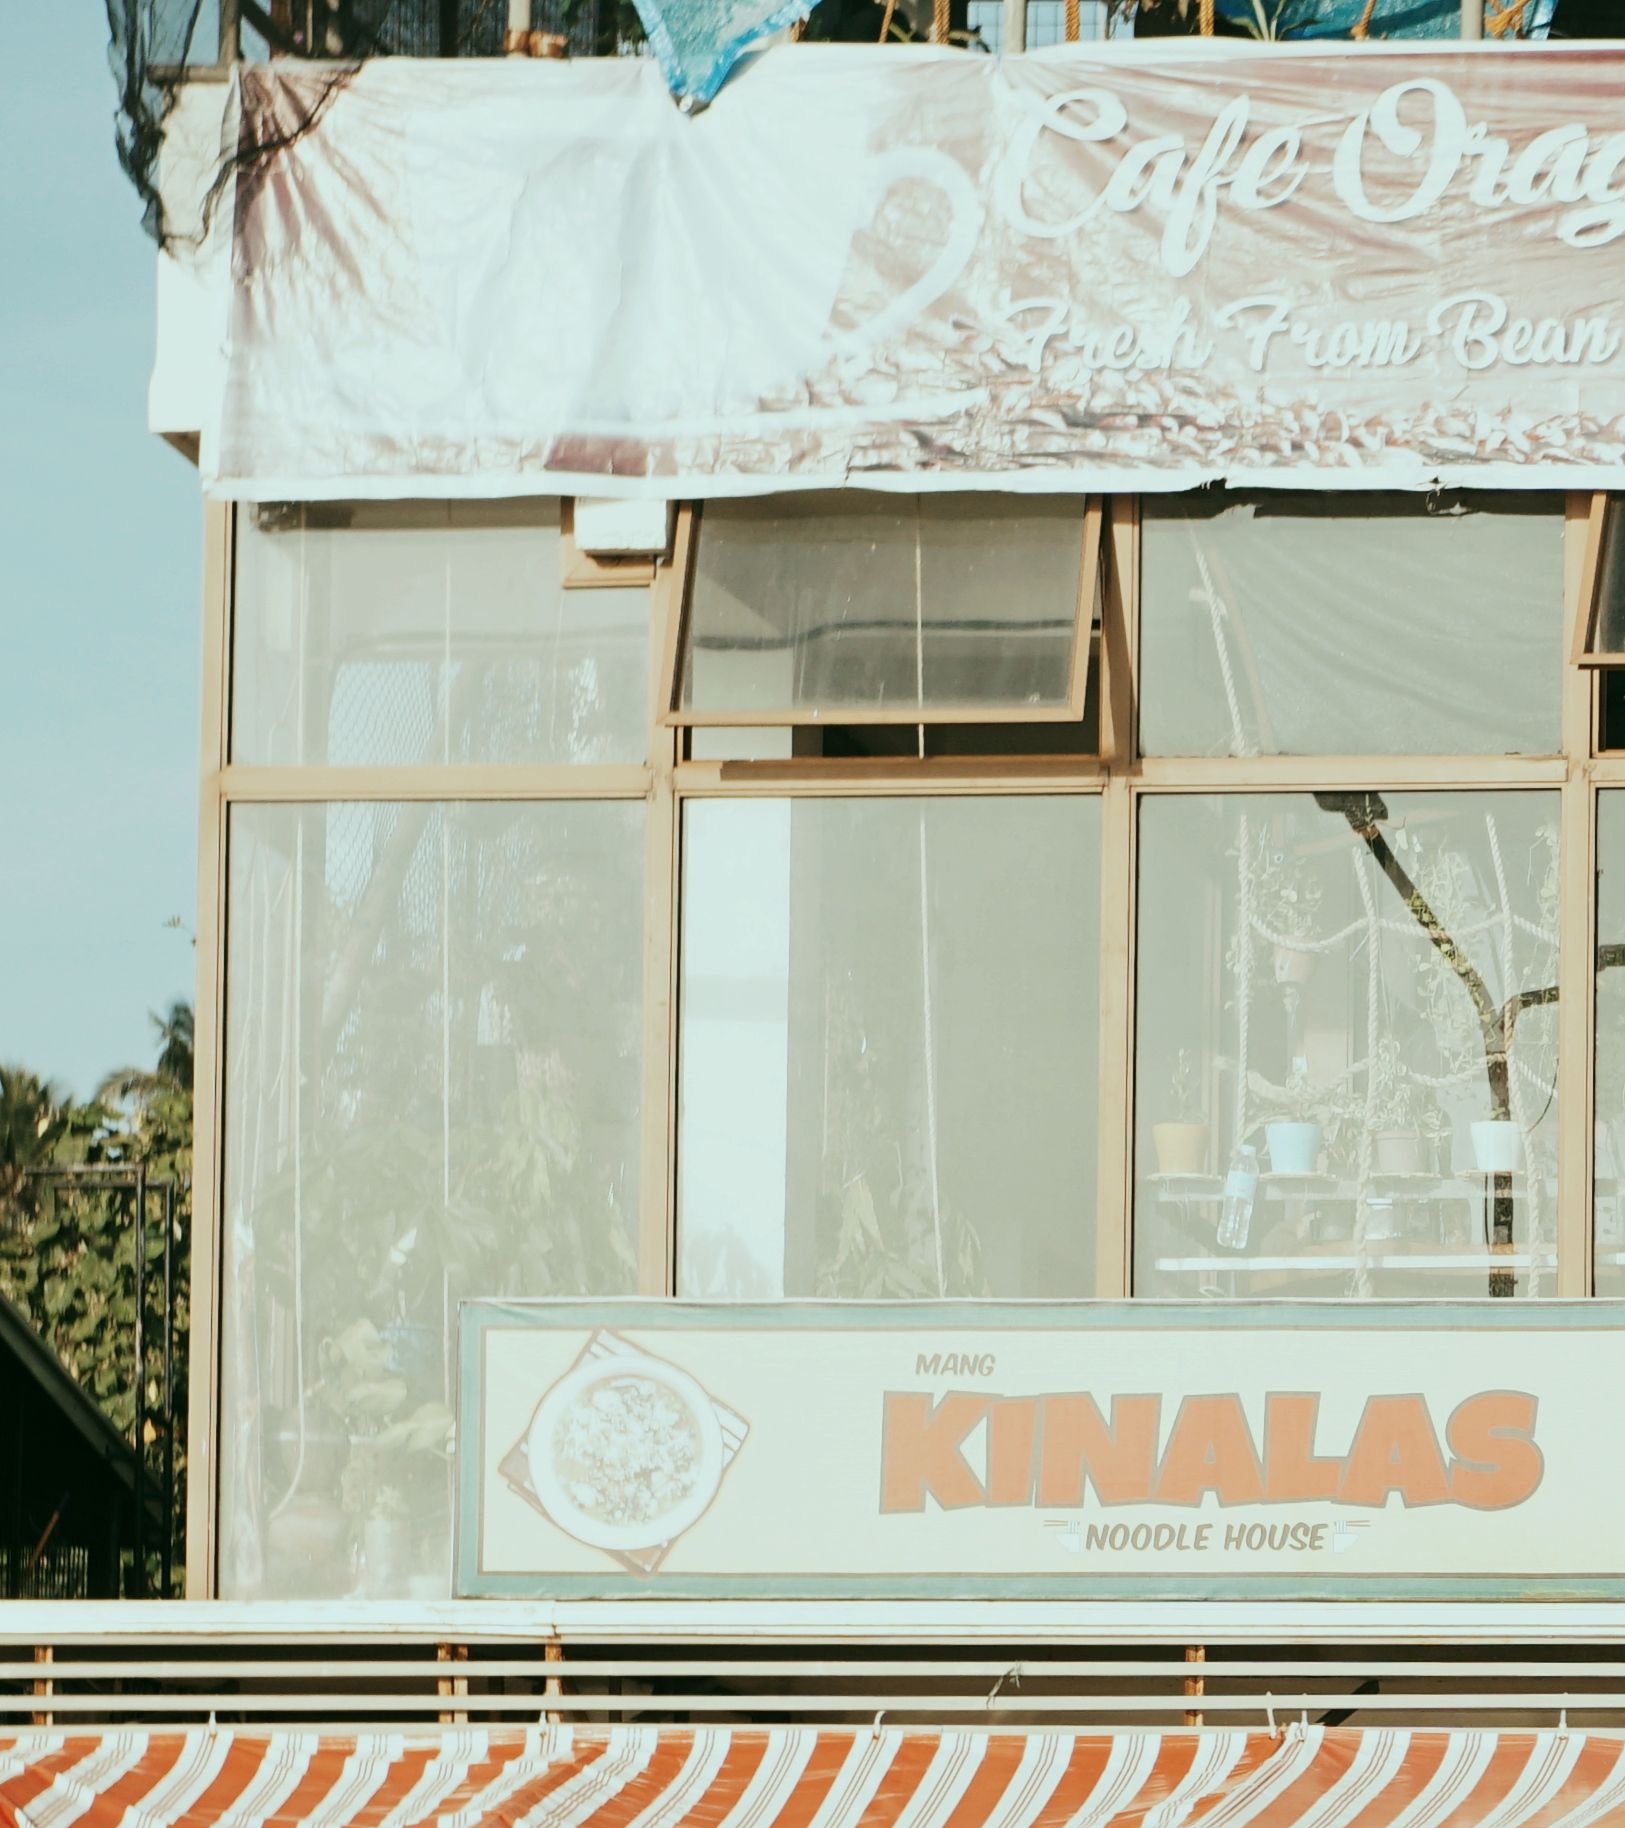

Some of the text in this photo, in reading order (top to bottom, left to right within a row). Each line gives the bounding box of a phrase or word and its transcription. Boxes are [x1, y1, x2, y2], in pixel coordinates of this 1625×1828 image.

[1001, 88, 1312, 277] Cafe
[1002, 296, 1213, 374] Fresh
[1216, 295, 1422, 372] From
[1427, 293, 1622, 368] Bean
[915, 1353, 997, 1377] MANG
[879, 1390, 1545, 1515] KINALAS
[1085, 1521, 1329, 1551] NOODLE HOUSE
